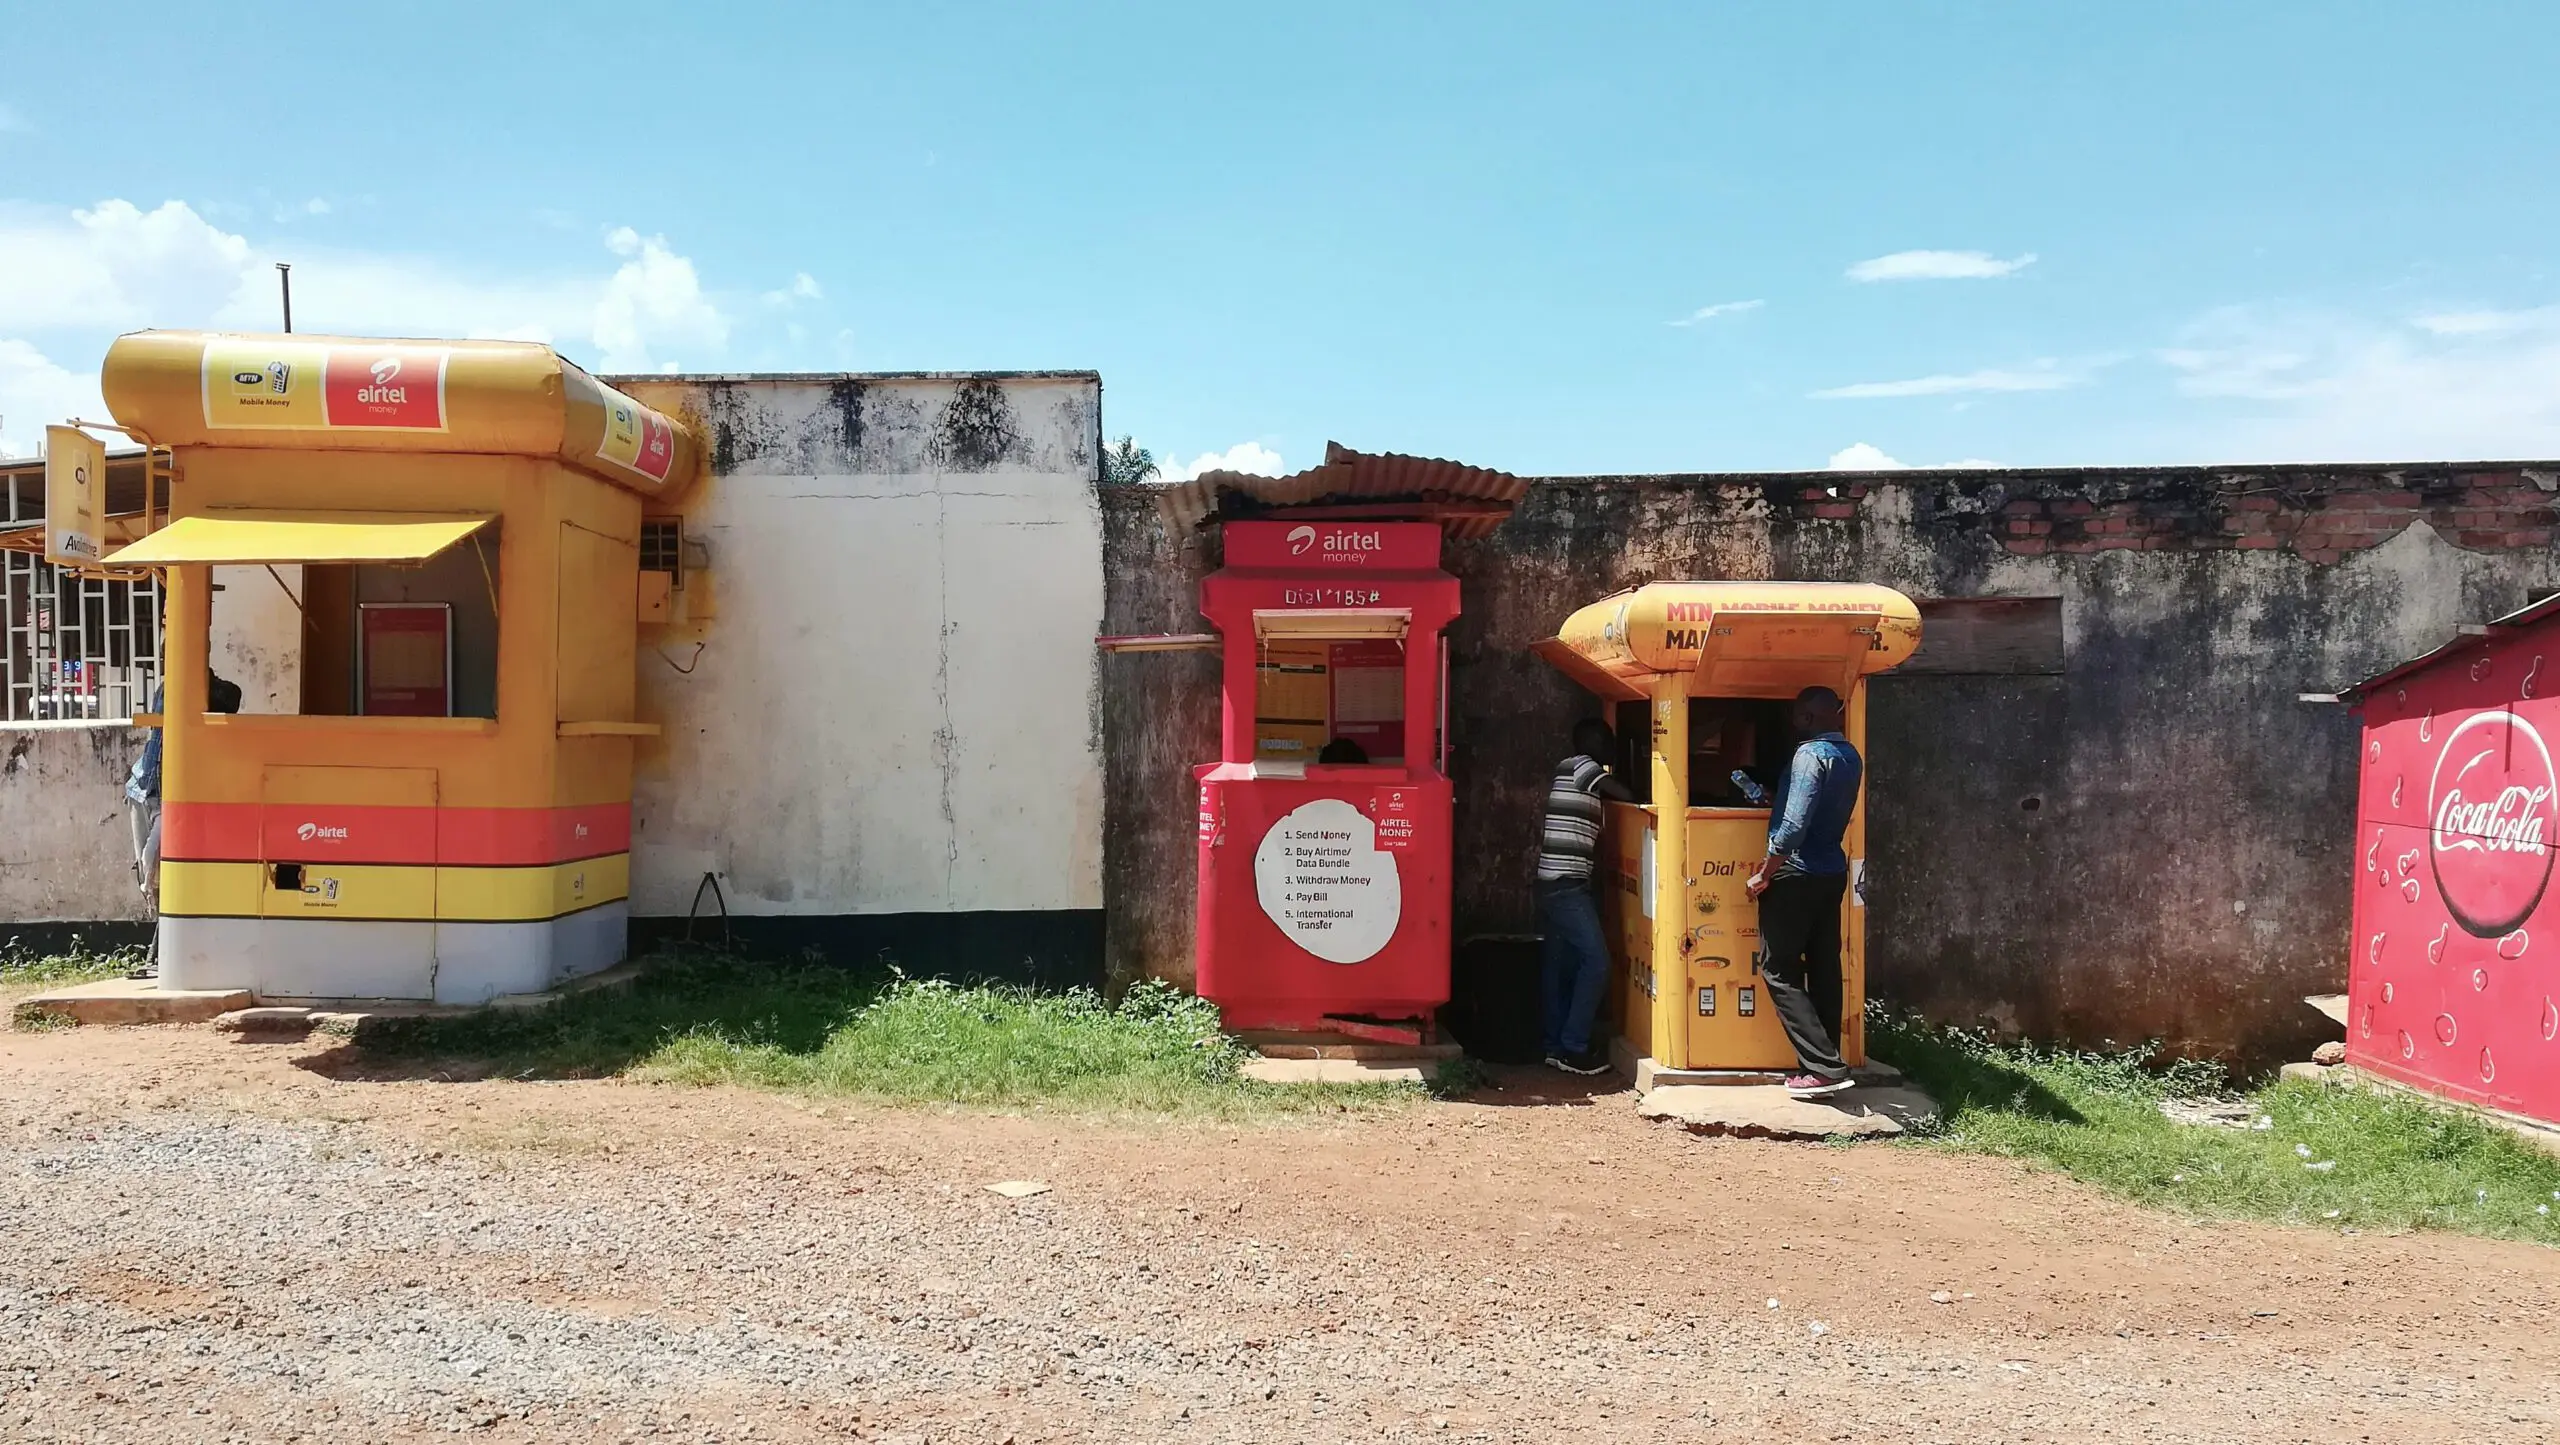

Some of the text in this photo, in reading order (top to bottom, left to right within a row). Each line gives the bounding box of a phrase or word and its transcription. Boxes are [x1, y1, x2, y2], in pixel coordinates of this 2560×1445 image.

[358, 385, 407, 404] airtel
[240, 398, 290, 408] Mobile Money
[368, 406, 397, 416] money
[1323, 529, 1382, 551] airtel
[1323, 553, 1367, 565] money
[1285, 589, 1321, 605] Dial
[1667, 602, 1713, 622] MTN
[1380, 818, 1412, 828] AIRTEL
[2435, 785, 2552, 855] Coca-Cola
[317, 826, 349, 838] airtel
[1284, 830, 1352, 841] 1. Send Money
[1379, 828, 1413, 838] MONEY
[1284, 847, 1352, 858] 2. Buy Airtime/
[1296, 859, 1351, 868] Data Bundle
[1702, 861, 1736, 877] Dial
[1284, 875, 1372, 886] 3. Withdraw Money
[1284, 892, 1329, 903] 4. Pay Bill
[1285, 909, 1354, 919] 5. International
[1297, 920, 1333, 930] Transfer
